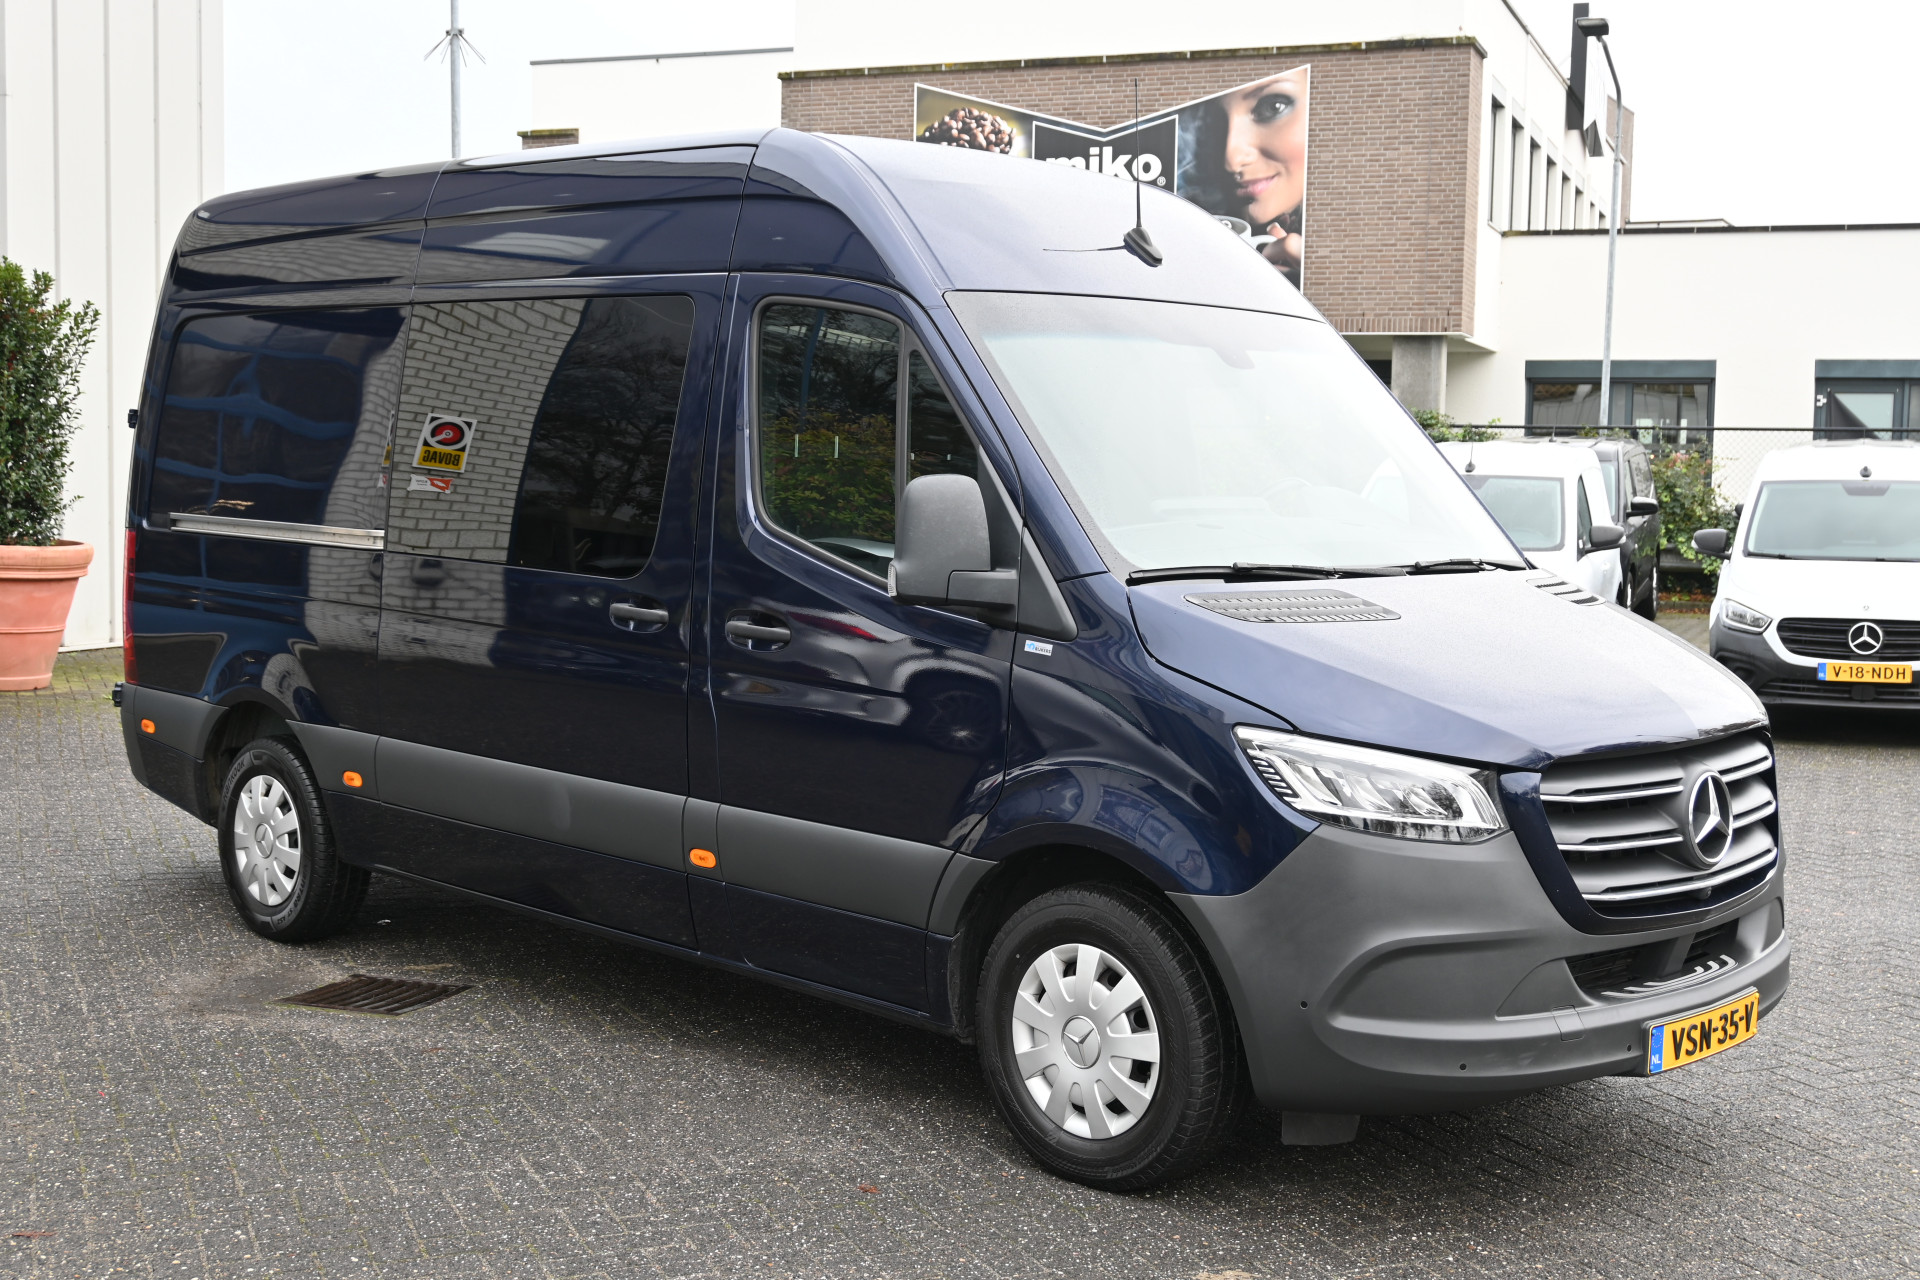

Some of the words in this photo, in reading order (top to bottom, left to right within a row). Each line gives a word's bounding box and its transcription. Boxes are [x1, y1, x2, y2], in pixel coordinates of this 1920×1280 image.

[1833, 665, 1906, 680] V-18-NDH
[1672, 1001, 1755, 1061] VSN-35-V
[1651, 1054, 1662, 1065] NL
